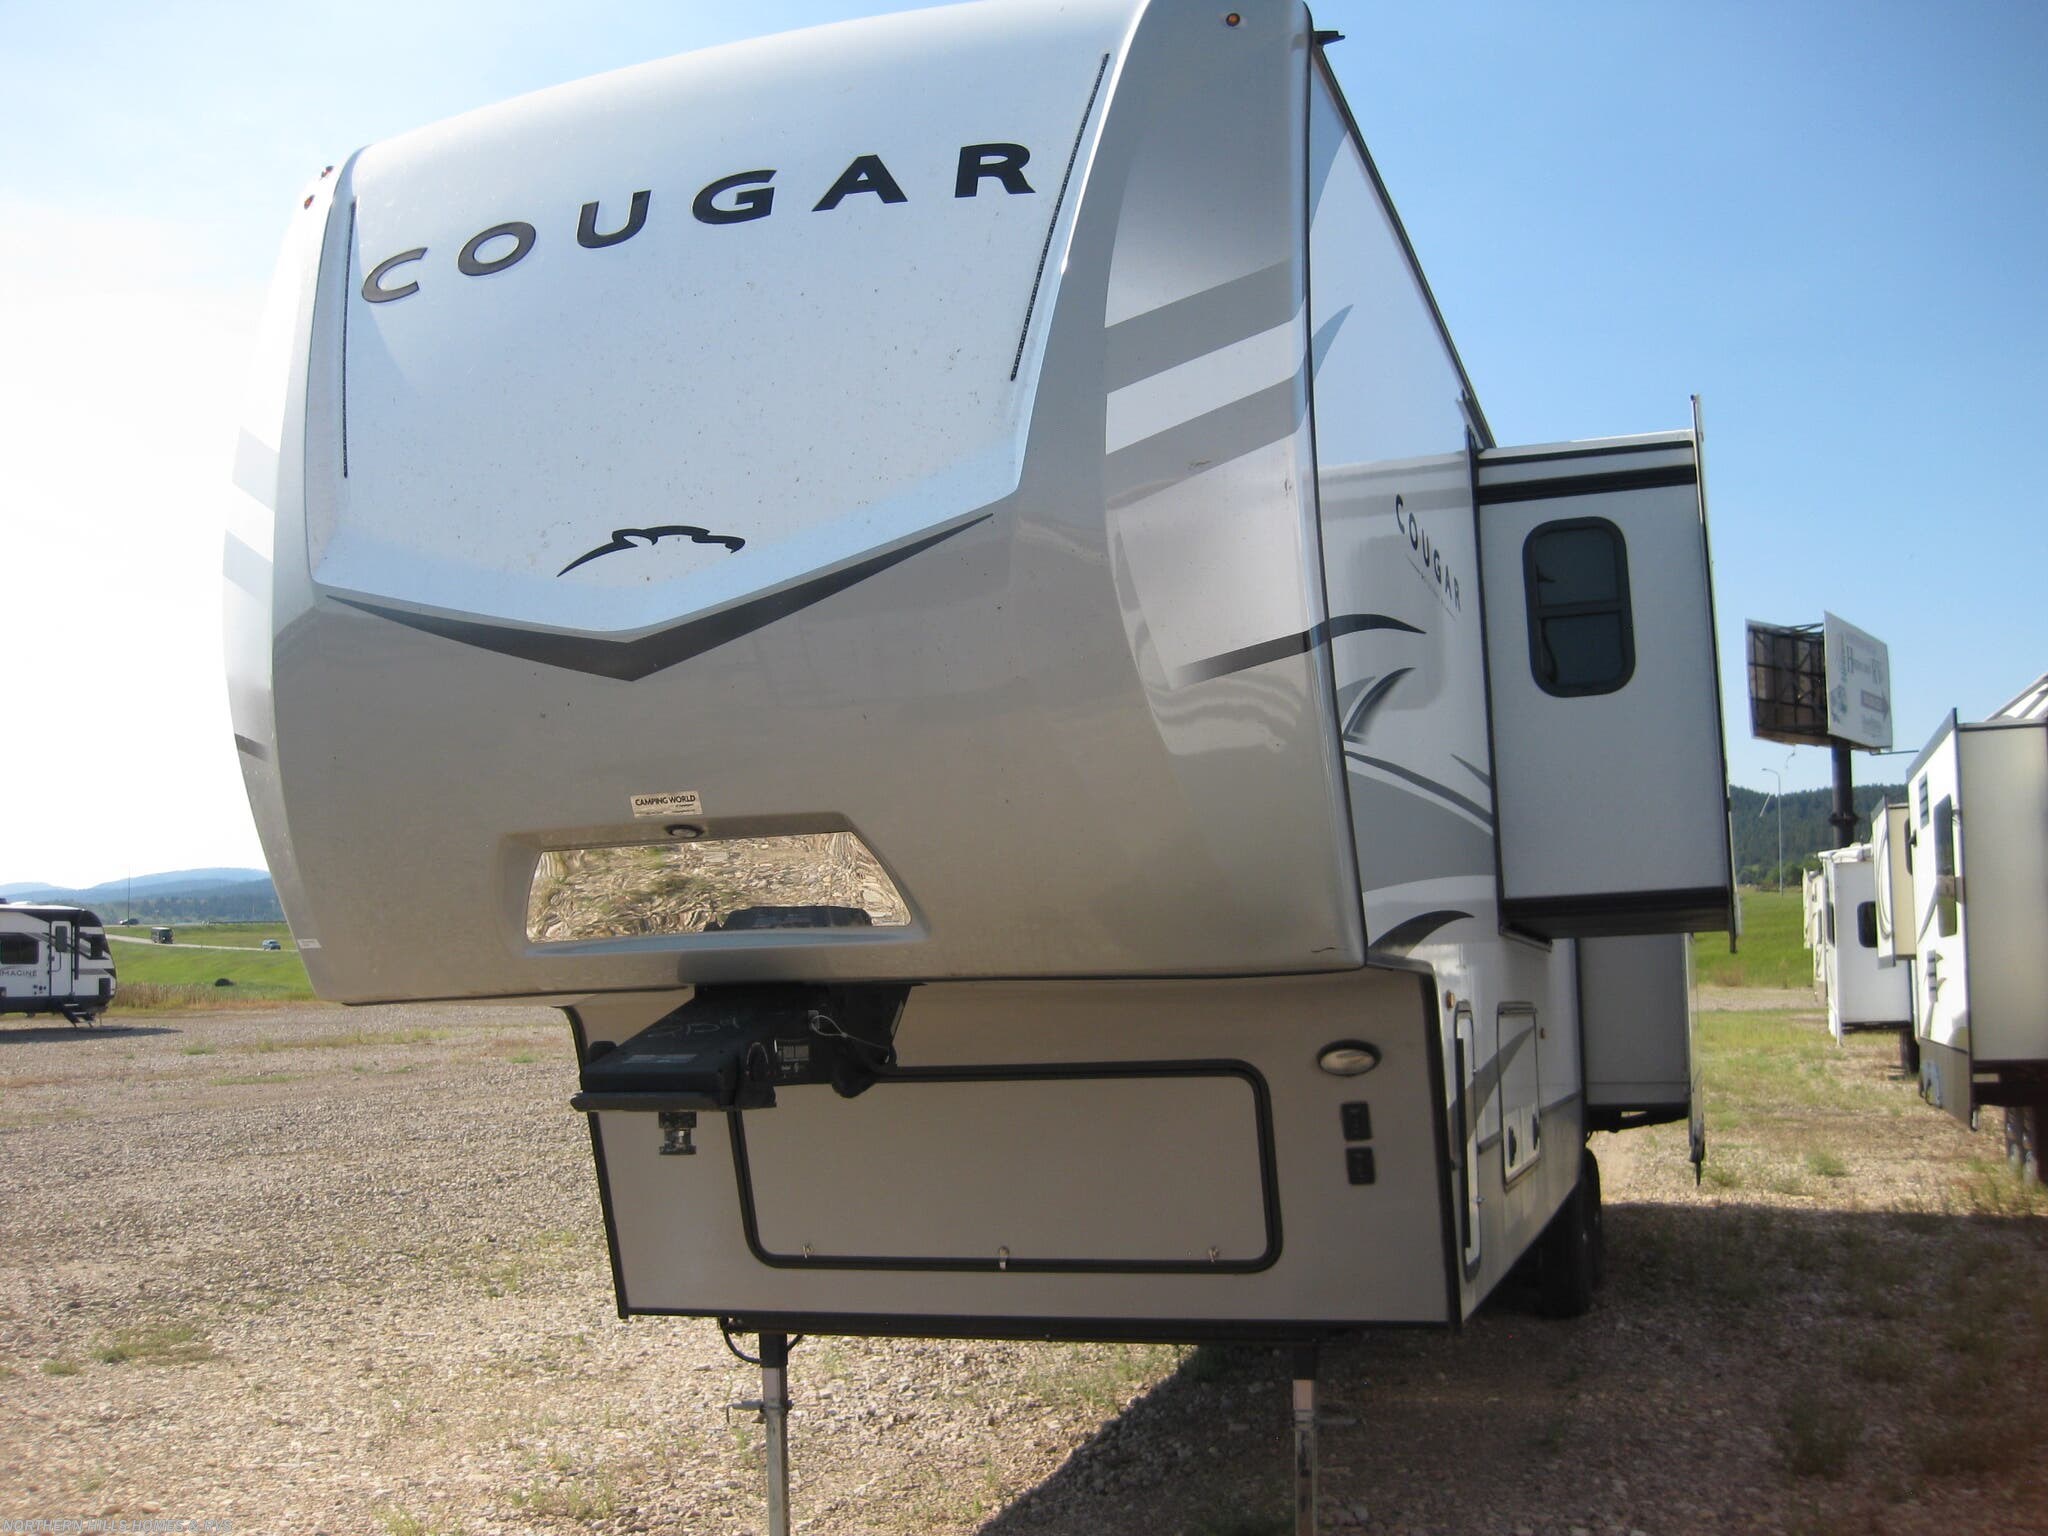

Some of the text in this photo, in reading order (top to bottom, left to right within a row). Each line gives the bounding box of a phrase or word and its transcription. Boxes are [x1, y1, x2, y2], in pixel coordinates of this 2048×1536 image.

[361, 142, 1037, 304] COUGAR
[1395, 493, 1461, 613] COUGAR
[635, 794, 696, 806] CAMPING WORLD
